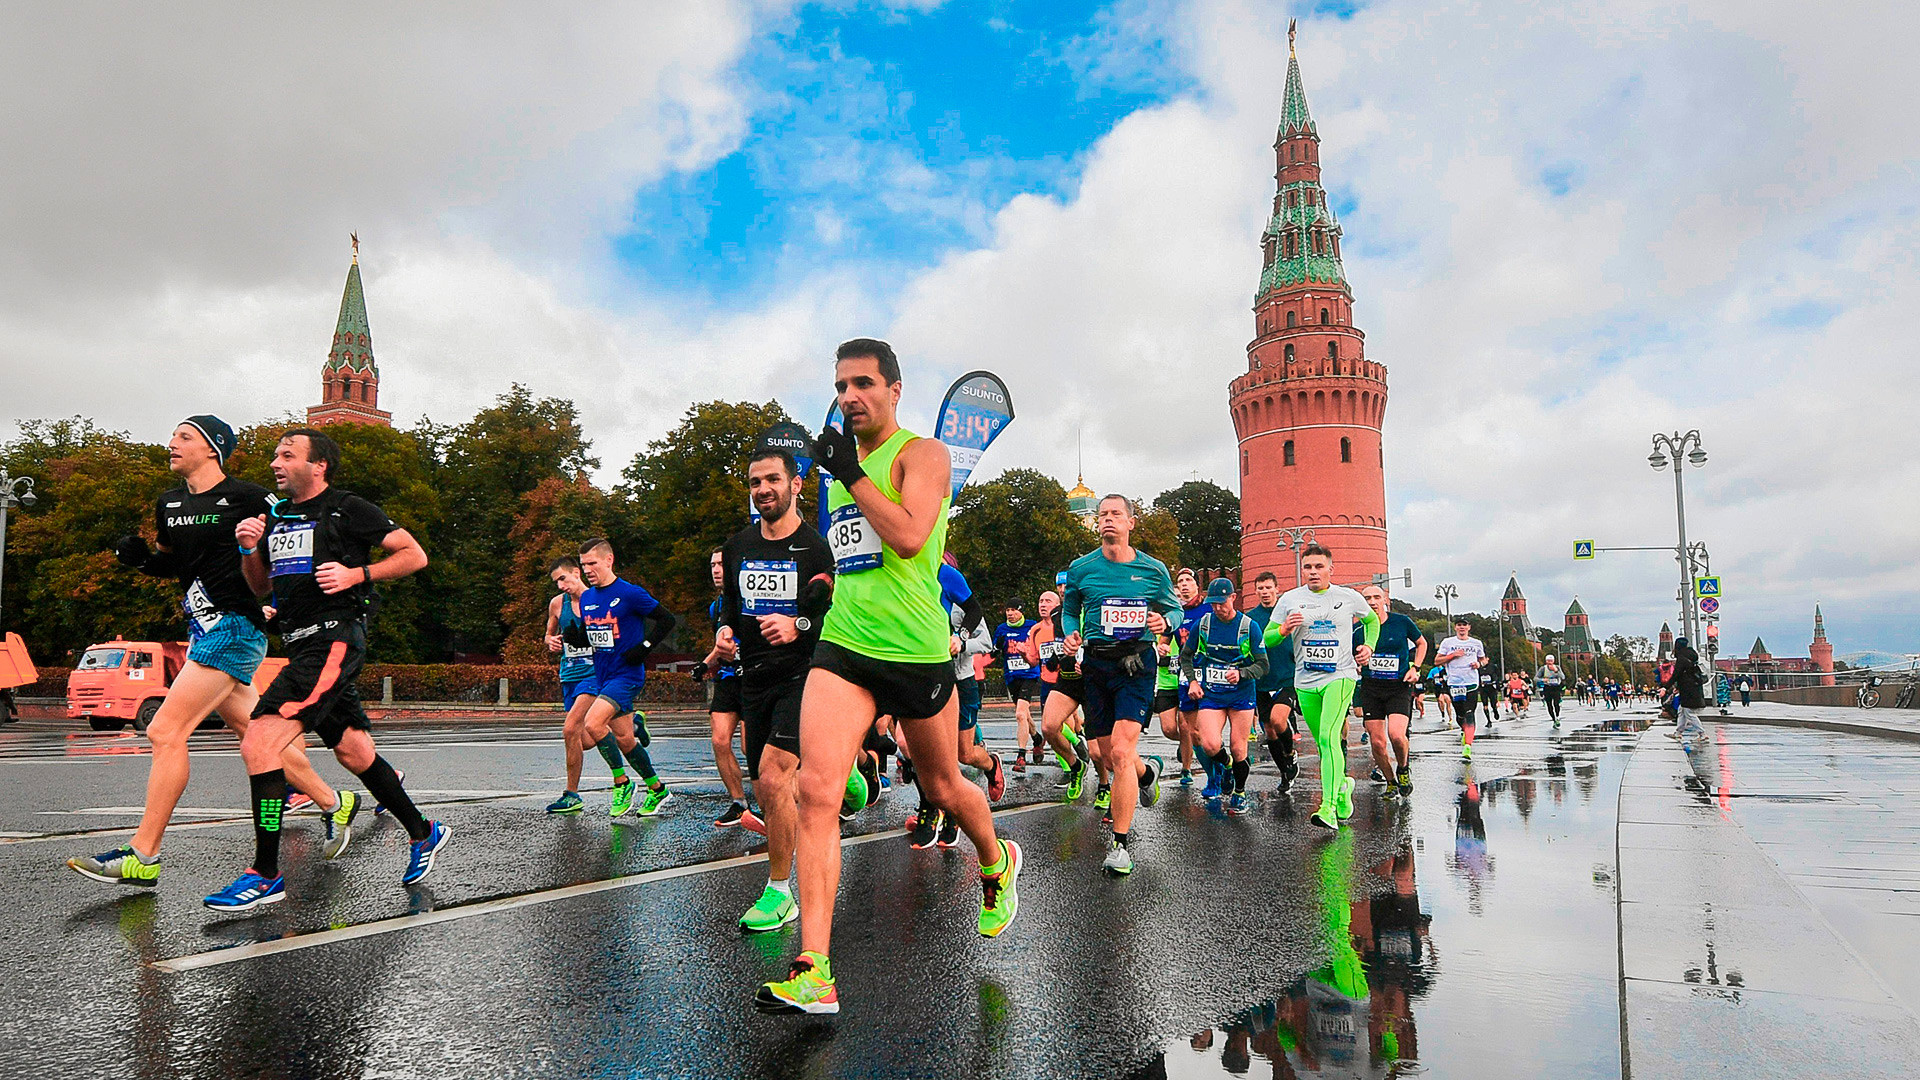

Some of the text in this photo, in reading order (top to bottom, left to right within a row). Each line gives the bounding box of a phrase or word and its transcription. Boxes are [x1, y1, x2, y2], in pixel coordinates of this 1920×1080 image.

[961, 384, 1004, 404] SUUNTO
[944, 409, 990, 444] 3:14
[767, 437, 804, 449] SUUNTO
[167, 514, 221, 528] RAWLIFE
[271, 532, 304, 553] 2961
[746, 573, 786, 592] 8251
[1103, 609, 1145, 624] 13595
[1306, 647, 1335, 659] 5430
[1371, 658, 1395, 668] 3424
[1208, 669, 1228, 679] 121
[258, 811, 280, 832] cep
